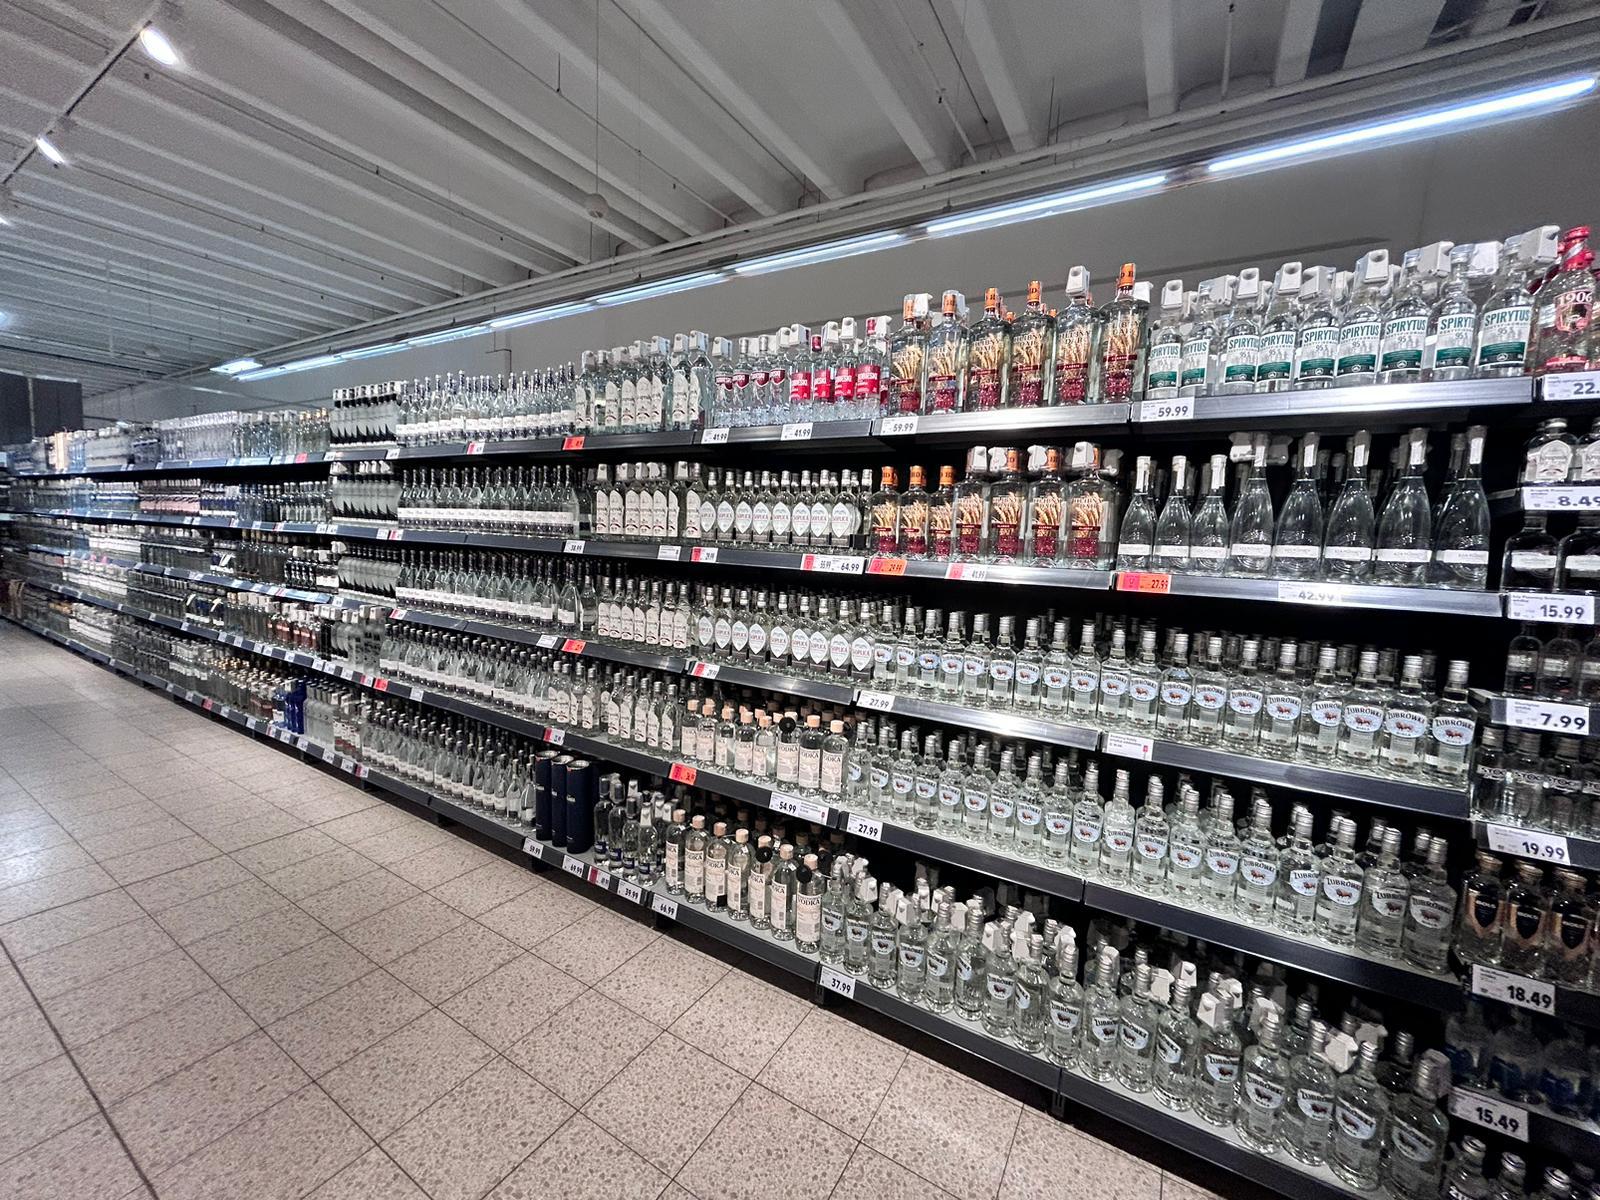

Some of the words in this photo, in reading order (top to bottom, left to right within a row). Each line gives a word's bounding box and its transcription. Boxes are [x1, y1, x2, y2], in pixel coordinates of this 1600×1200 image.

[1558, 291, 1593, 303] 1906
[1486, 310, 1530, 326] SPIRYTUS
[1342, 325, 1379, 340] SPIRYTUS
[1387, 319, 1426, 335] SPIRYTUS
[1261, 334, 1294, 347] SPIRYTUS
[1158, 405, 1188, 418] 59.99
[794, 428, 810, 438] 41.99
[893, 422, 914, 432] 59.99
[713, 433, 727, 441] 41.99
[841, 563, 859, 571] 64.99
[1540, 604, 1584, 620] 15.99
[869, 698, 890, 709] 27.99
[1540, 713, 1586, 730] 7.99
[779, 801, 796, 813] 54.99
[858, 824, 878, 837] 27.99
[1522, 842, 1565, 859] 19.99
[570, 864, 582, 874] 69.99
[625, 887, 639, 900] 39.99
[660, 903, 675, 916] 66.99
[831, 978, 851, 993] 37.99
[1507, 985, 1552, 1007] 18.49
[1476, 1107, 1519, 1132] 15.49
